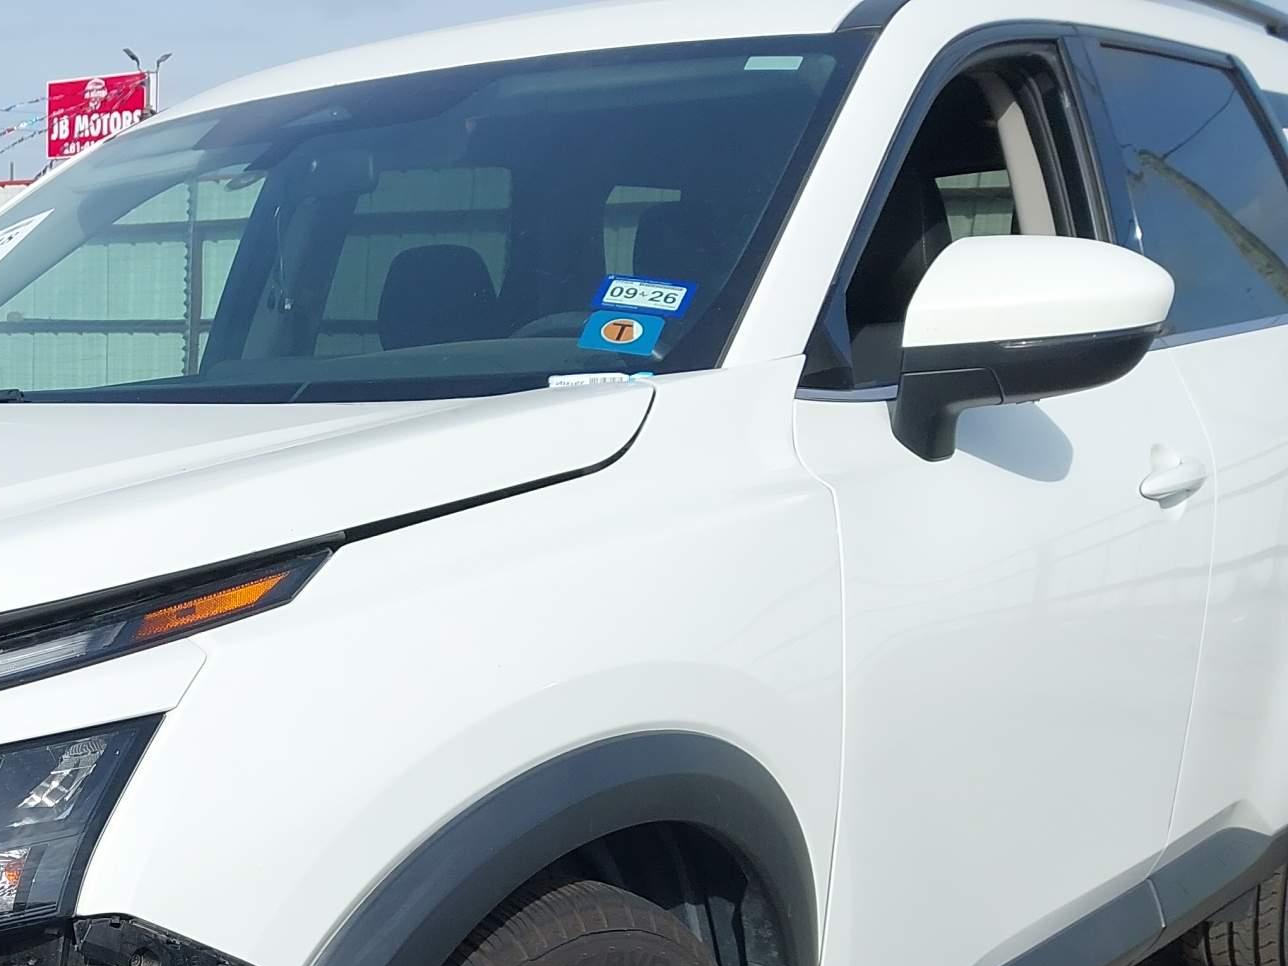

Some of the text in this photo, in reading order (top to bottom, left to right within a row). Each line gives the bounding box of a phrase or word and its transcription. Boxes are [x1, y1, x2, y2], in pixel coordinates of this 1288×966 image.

[51, 109, 142, 140] JB MOTORS
[610, 287, 638, 299] 09
[648, 291, 679, 304] 26
